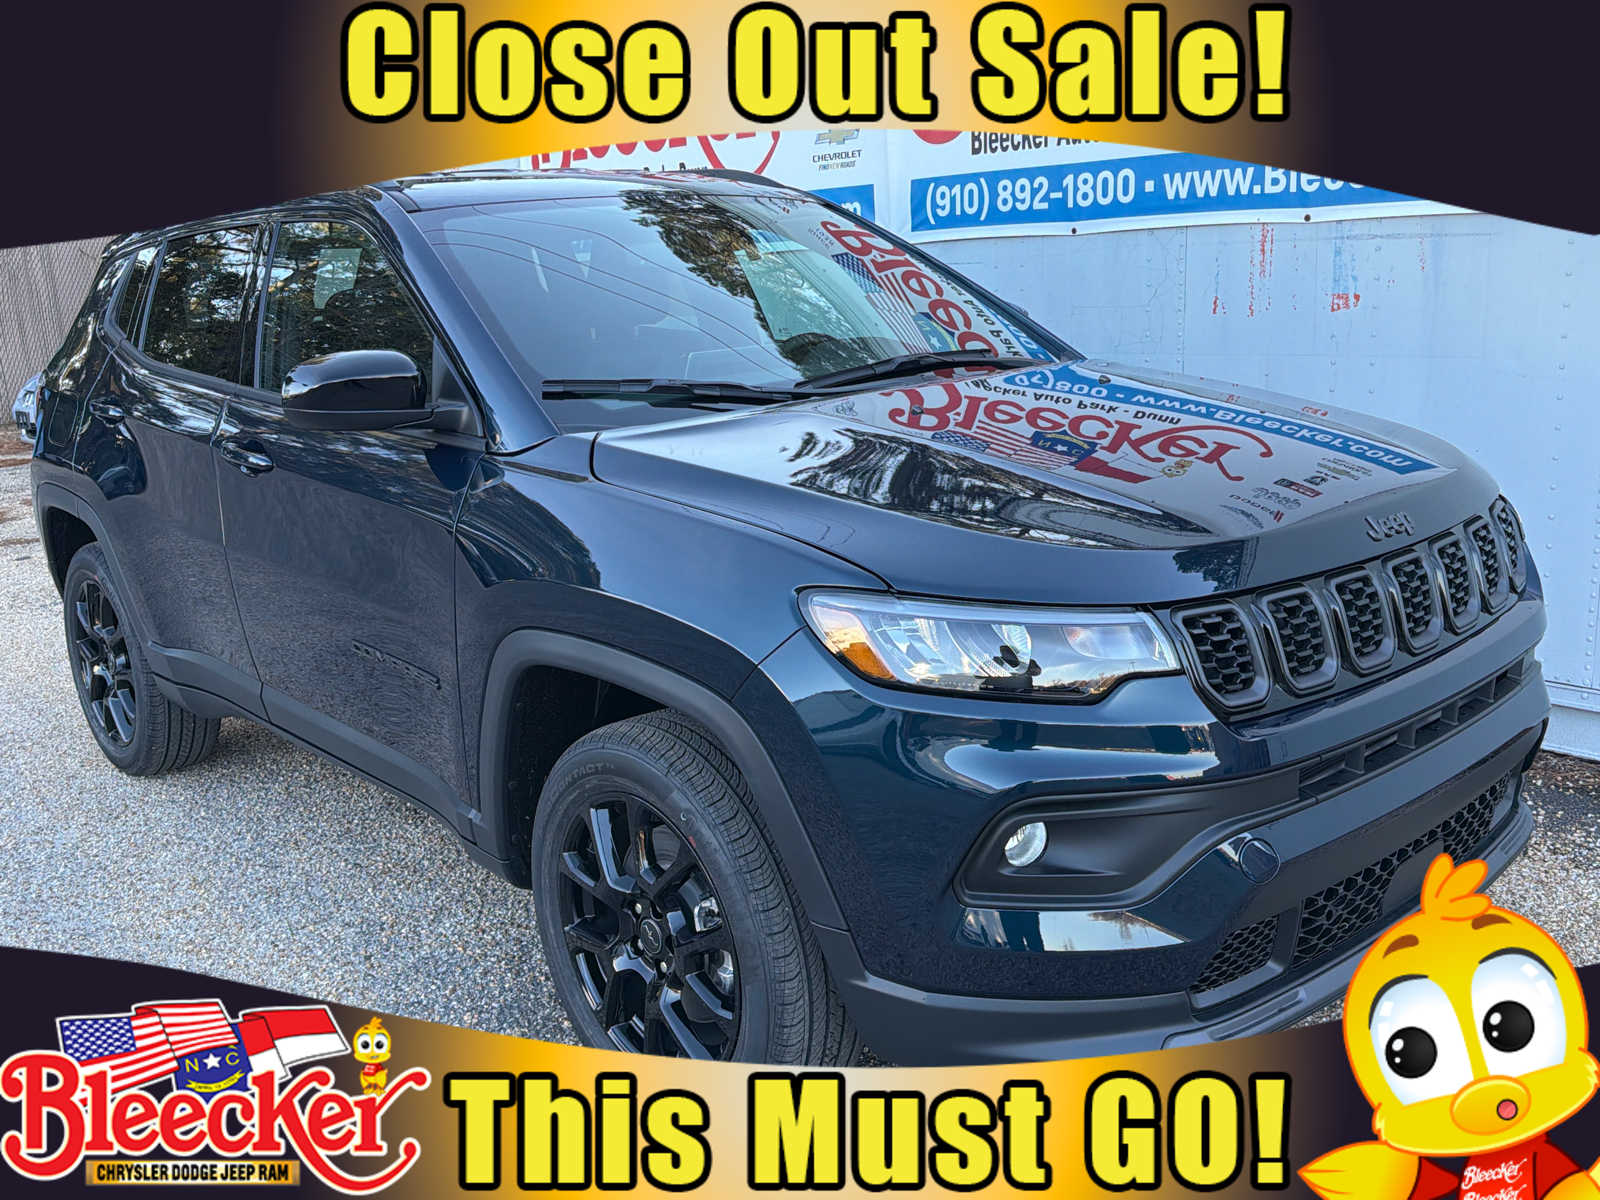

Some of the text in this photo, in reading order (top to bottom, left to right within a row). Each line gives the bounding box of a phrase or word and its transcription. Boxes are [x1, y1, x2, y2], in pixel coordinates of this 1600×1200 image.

[812, 149, 862, 163] CHEVROLET
[926, 177, 990, 224] (910)
[996, 169, 1136, 213] 892-1800
[1364, 511, 1415, 542] Jeep
